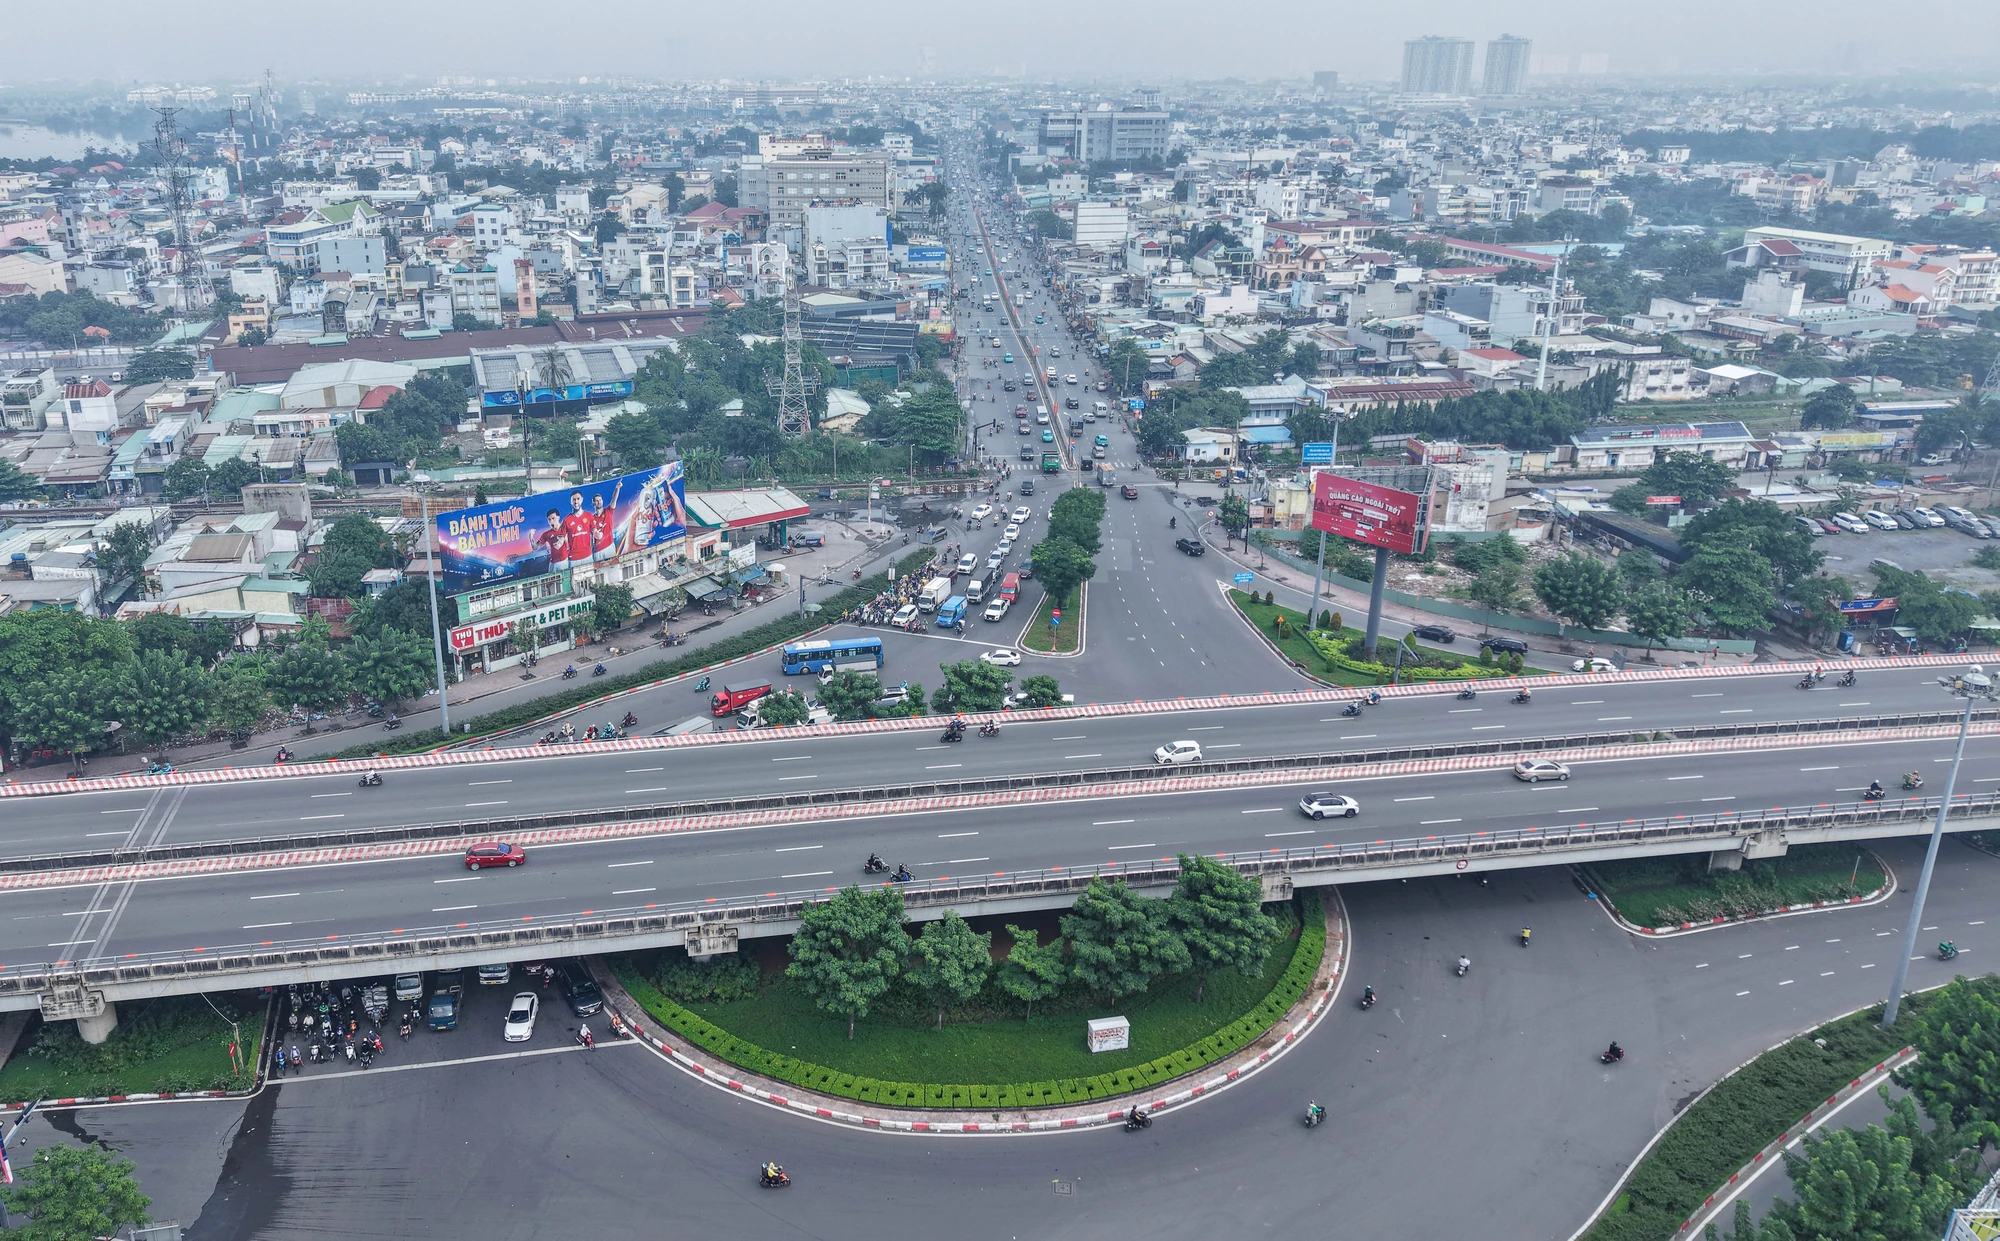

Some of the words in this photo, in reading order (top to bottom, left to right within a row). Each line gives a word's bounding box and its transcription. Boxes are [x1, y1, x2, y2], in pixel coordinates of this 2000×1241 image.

[449, 514, 488, 536] ĐÁNH
[489, 505, 526, 528] THỨC
[458, 530, 487, 552] BẢN
[539, 612, 547, 625] &
[548, 607, 566, 622] PET
[567, 600, 592, 617] MART
[455, 629, 472, 641] THÚ
[460, 639, 466, 647] Y
